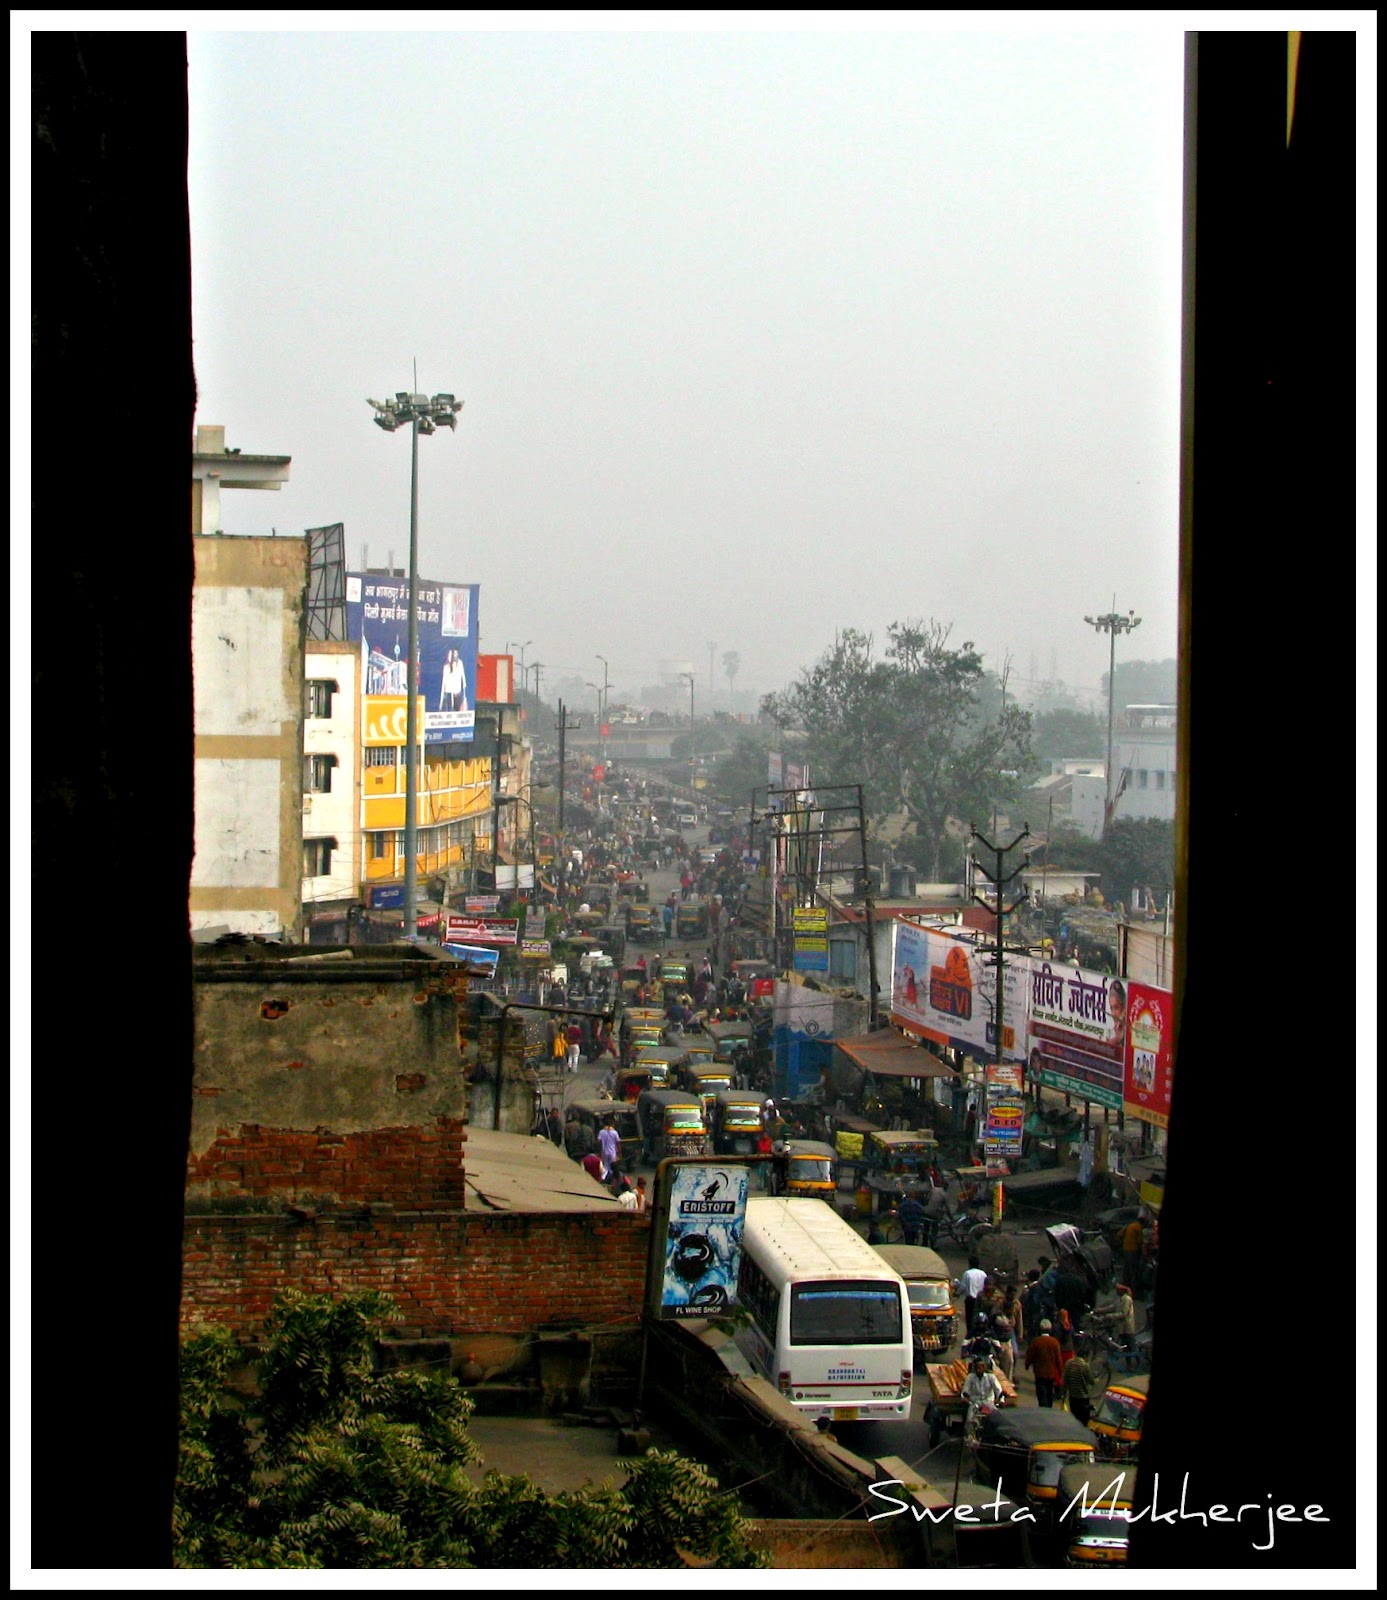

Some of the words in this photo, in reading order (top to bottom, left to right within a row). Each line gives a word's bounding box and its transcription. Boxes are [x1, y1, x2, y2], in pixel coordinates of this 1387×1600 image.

[1032, 962, 1064, 1012] सचिन
[1067, 970, 1108, 1024] ज्वेलर्स
[683, 1202, 733, 1213] ERISTOFF
[685, 1306, 702, 1314] WINE
[703, 1306, 722, 1314] SHOP
